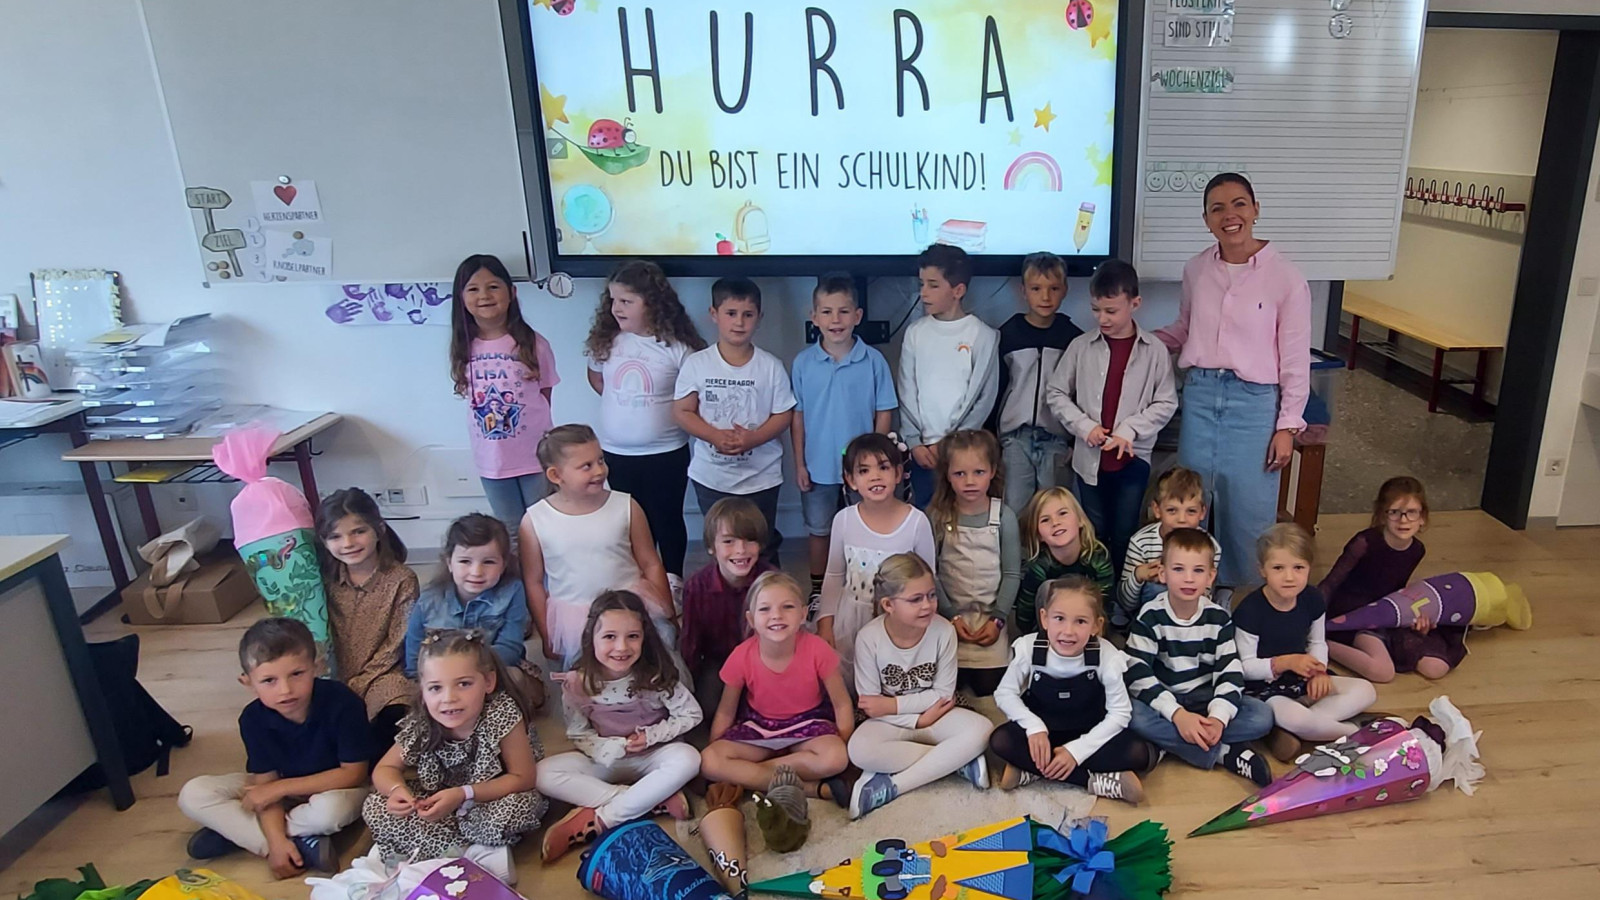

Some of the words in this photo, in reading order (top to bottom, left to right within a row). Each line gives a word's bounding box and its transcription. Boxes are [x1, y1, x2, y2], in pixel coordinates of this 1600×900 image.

[1168, 21, 1191, 38] SIND
[618, 7, 1015, 124] HURRA
[660, 151, 695, 188] DU
[710, 150, 759, 188] BIST
[777, 152, 820, 190] EIN
[838, 150, 987, 191] SCHULKIND!
[194, 192, 223, 205] START
[213, 234, 233, 248] ZIEL
[475, 369, 508, 381] LISA
[728, 379, 755, 387] DRAGON
